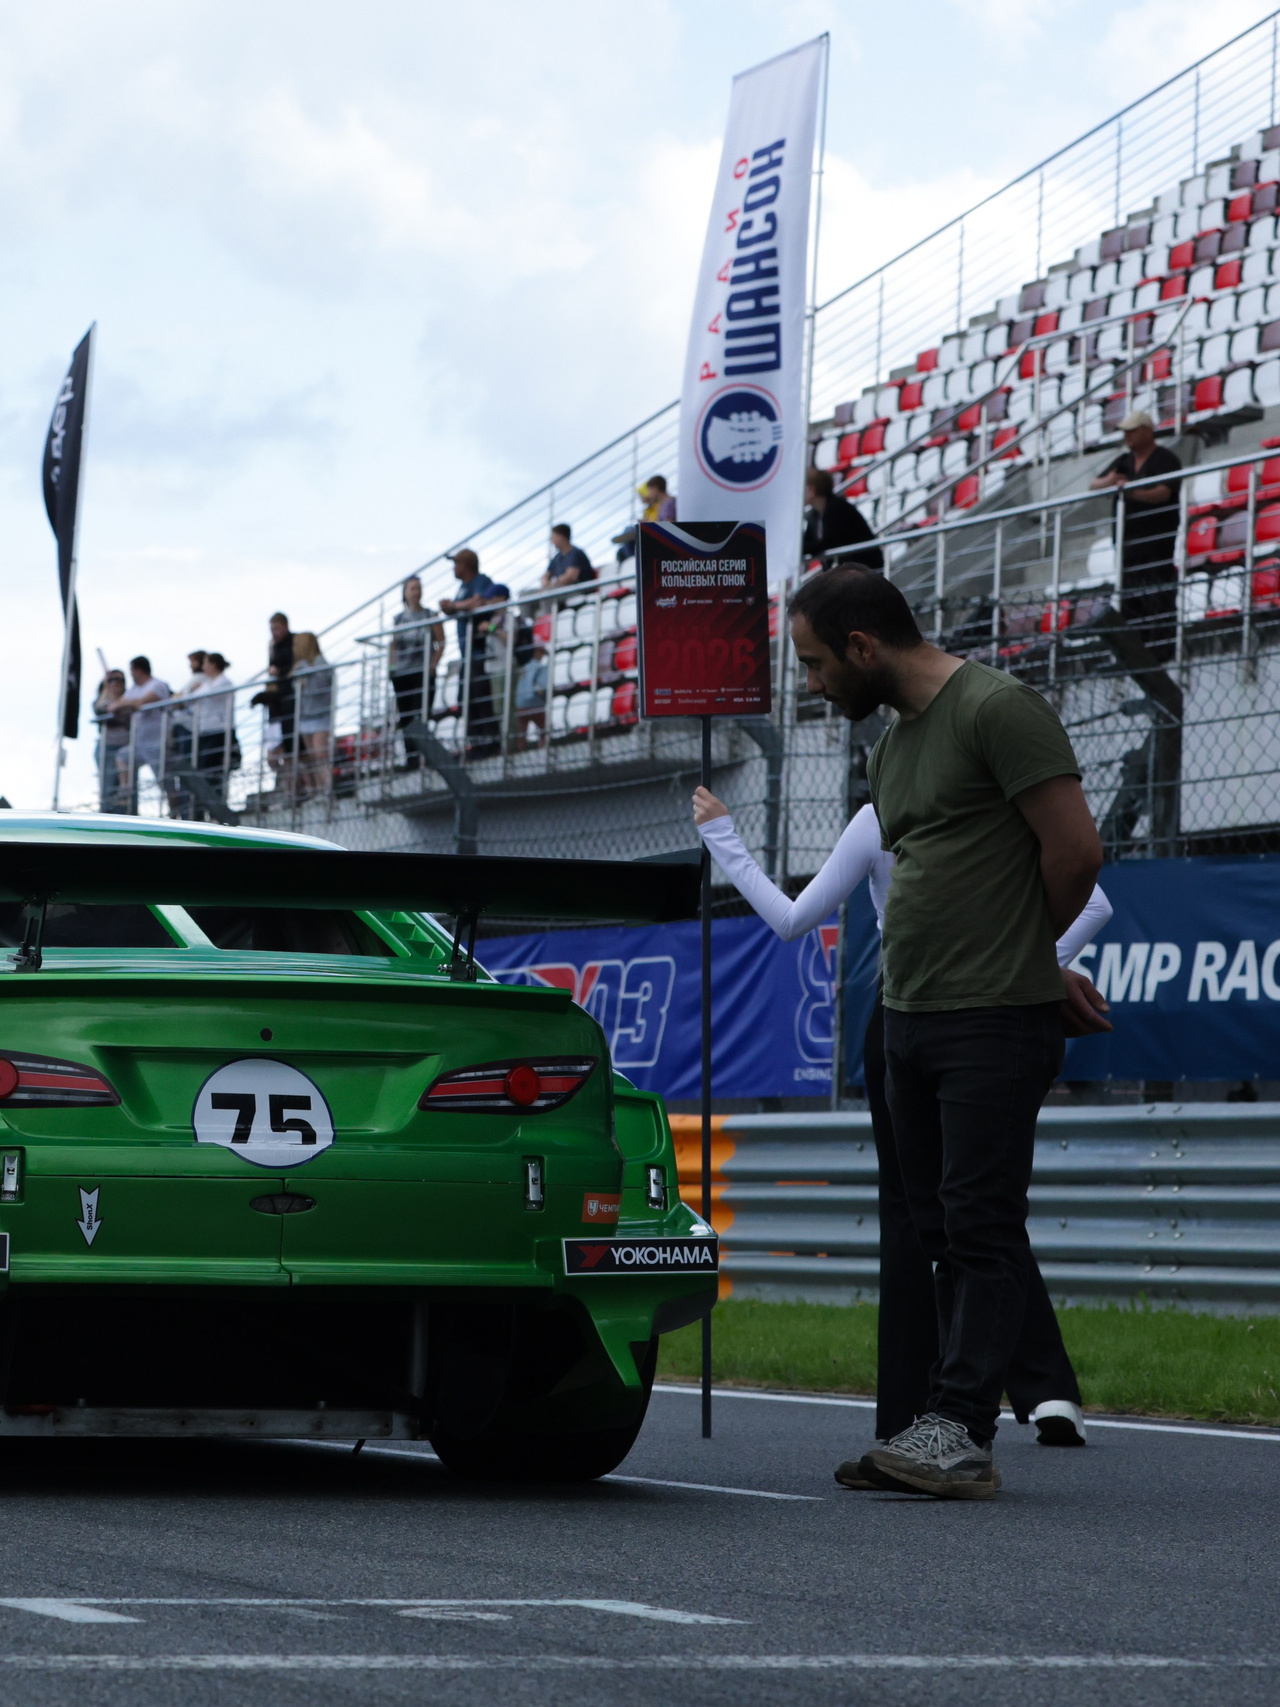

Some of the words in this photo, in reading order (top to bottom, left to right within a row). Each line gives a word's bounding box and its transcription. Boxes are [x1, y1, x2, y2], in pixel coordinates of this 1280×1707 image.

[724, 138, 786, 376] ШАНСОН
[661, 558, 717, 573] РОССИЙСКАЯ
[718, 559, 747, 572] СЕРИЯ
[661, 574, 716, 588] КОЛЬЦЕВЫХ
[717, 574, 746, 587] ГОНОК
[1067, 941, 1183, 1003] SMP
[211, 1092, 318, 1145] 75
[610, 1246, 713, 1265] YOKOHAMA
